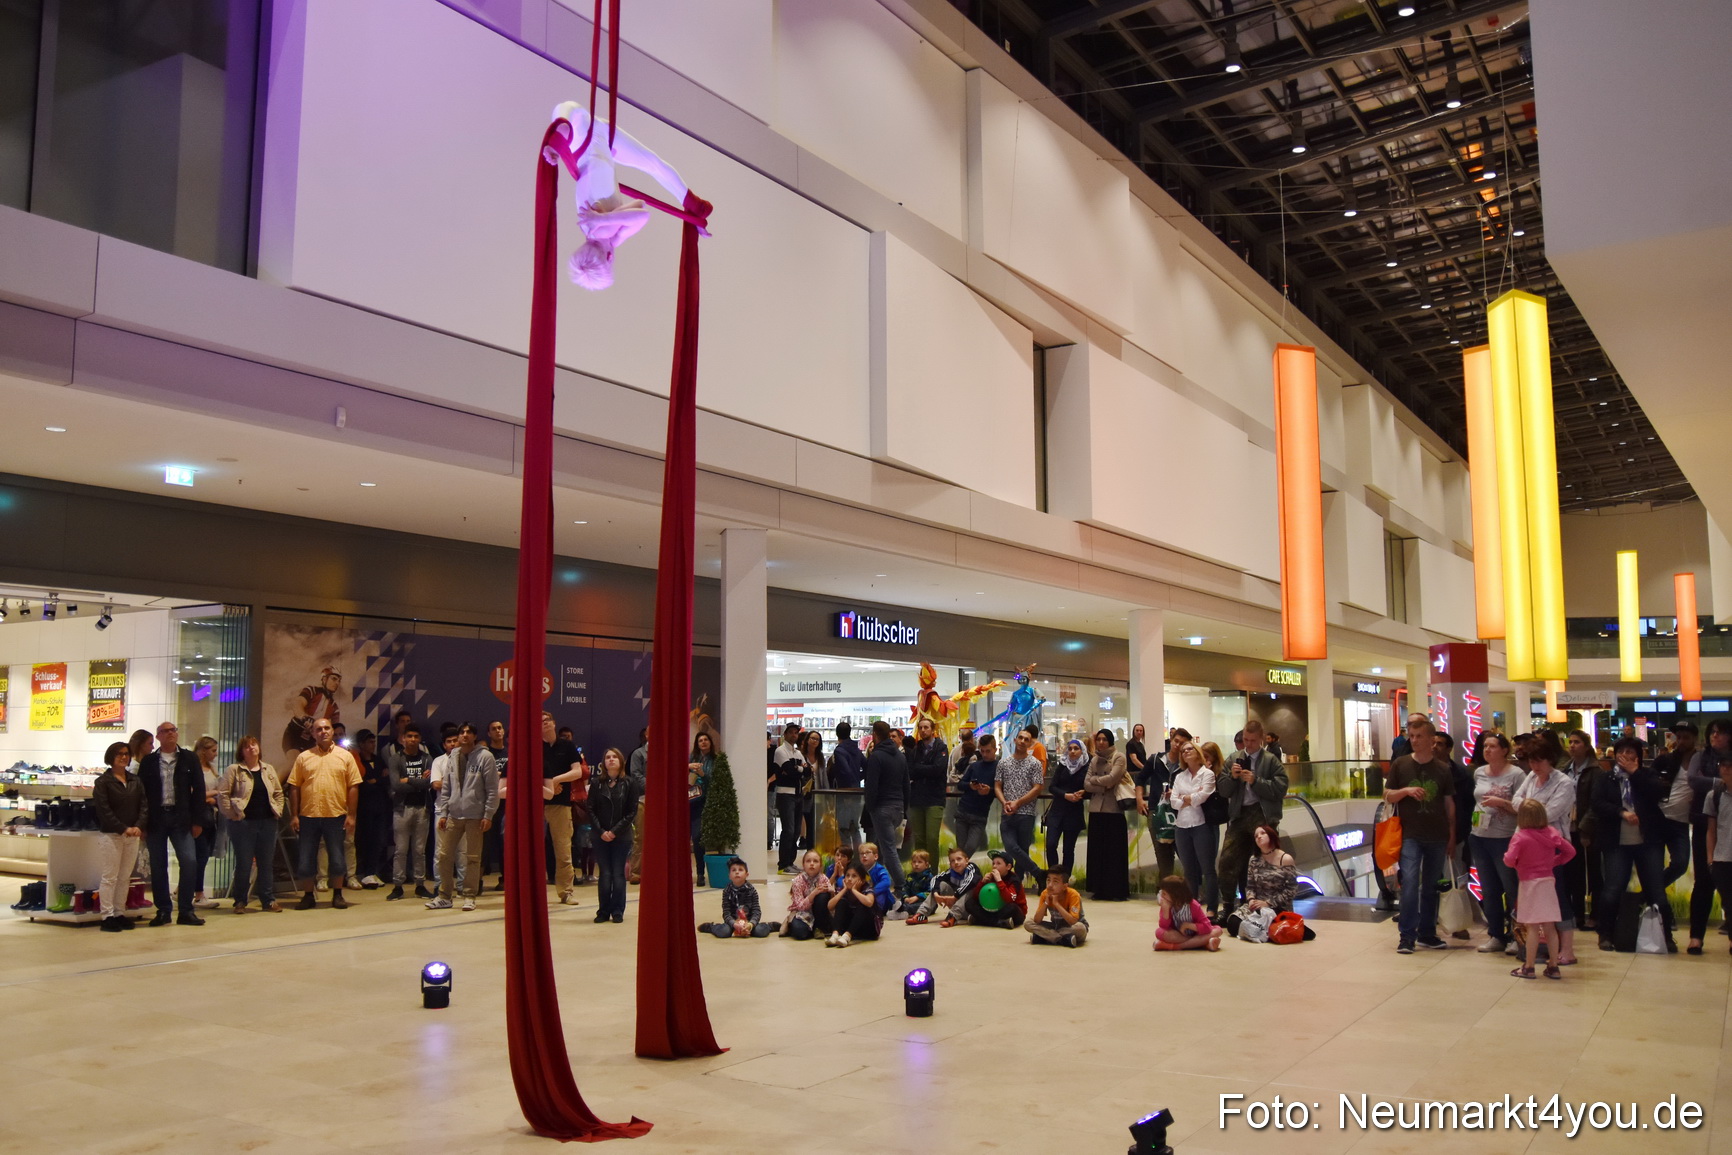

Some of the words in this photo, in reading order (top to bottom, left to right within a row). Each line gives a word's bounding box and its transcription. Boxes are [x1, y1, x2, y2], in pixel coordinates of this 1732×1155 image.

[857, 615, 920, 645] hübscher
[35, 671, 60, 681] Schluss-
[566, 667, 584, 675] STORE
[40, 680, 63, 691] verkauf
[566, 681, 587, 690] ONLINE
[779, 681, 796, 692] Gute
[797, 680, 841, 693] Unterhaltung
[93, 688, 122, 699] VERKAUF!
[566, 696, 587, 704] MOBILE
[47, 705, 60, 716] 70%
[91, 707, 107, 718] 30%
